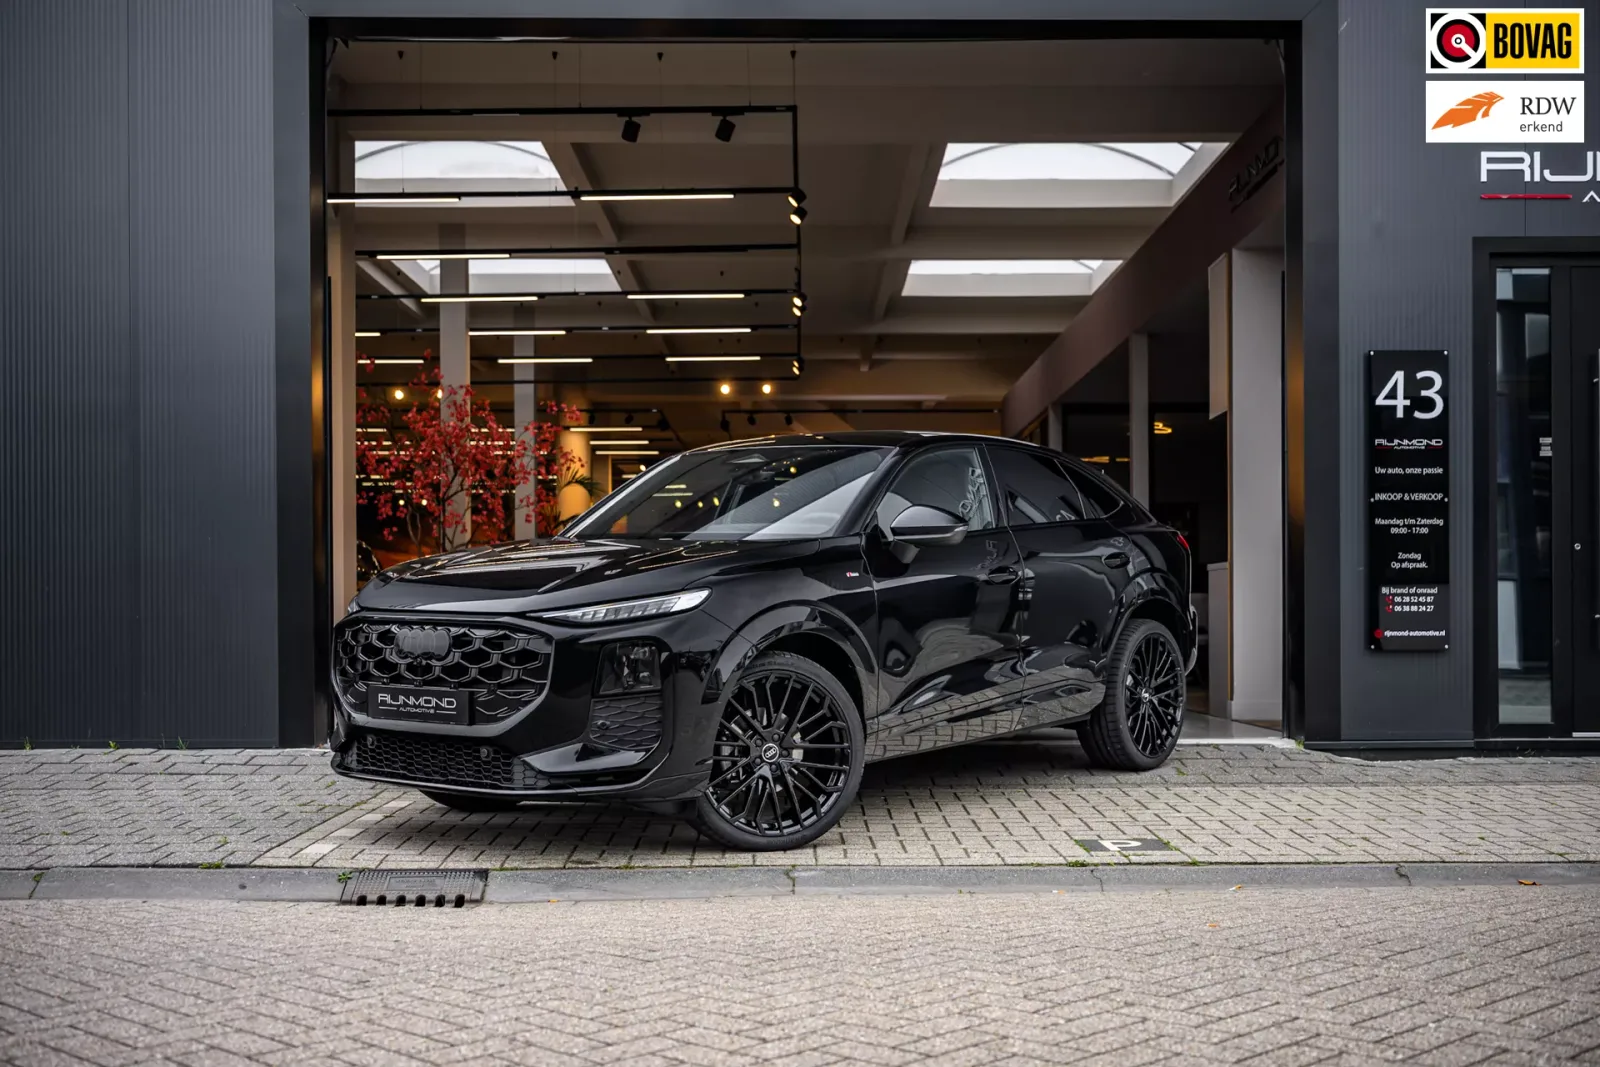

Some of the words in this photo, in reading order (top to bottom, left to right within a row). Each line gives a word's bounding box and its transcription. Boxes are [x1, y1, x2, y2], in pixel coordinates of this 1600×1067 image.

[1480, 151, 1600, 182] RIJ
[1375, 370, 1444, 419] 43
[1387, 467, 1404, 475] auto,
[1423, 466, 1443, 475] passie
[1375, 518, 1403, 526] Maandag
[1416, 518, 1443, 526] Zaterdag
[1398, 552, 1421, 560] Zondag
[1401, 561, 1428, 569] afspraak.
[1381, 587, 1389, 595] Bij
[378, 693, 457, 708] RIJNMOND
[1098, 840, 1142, 851] P
